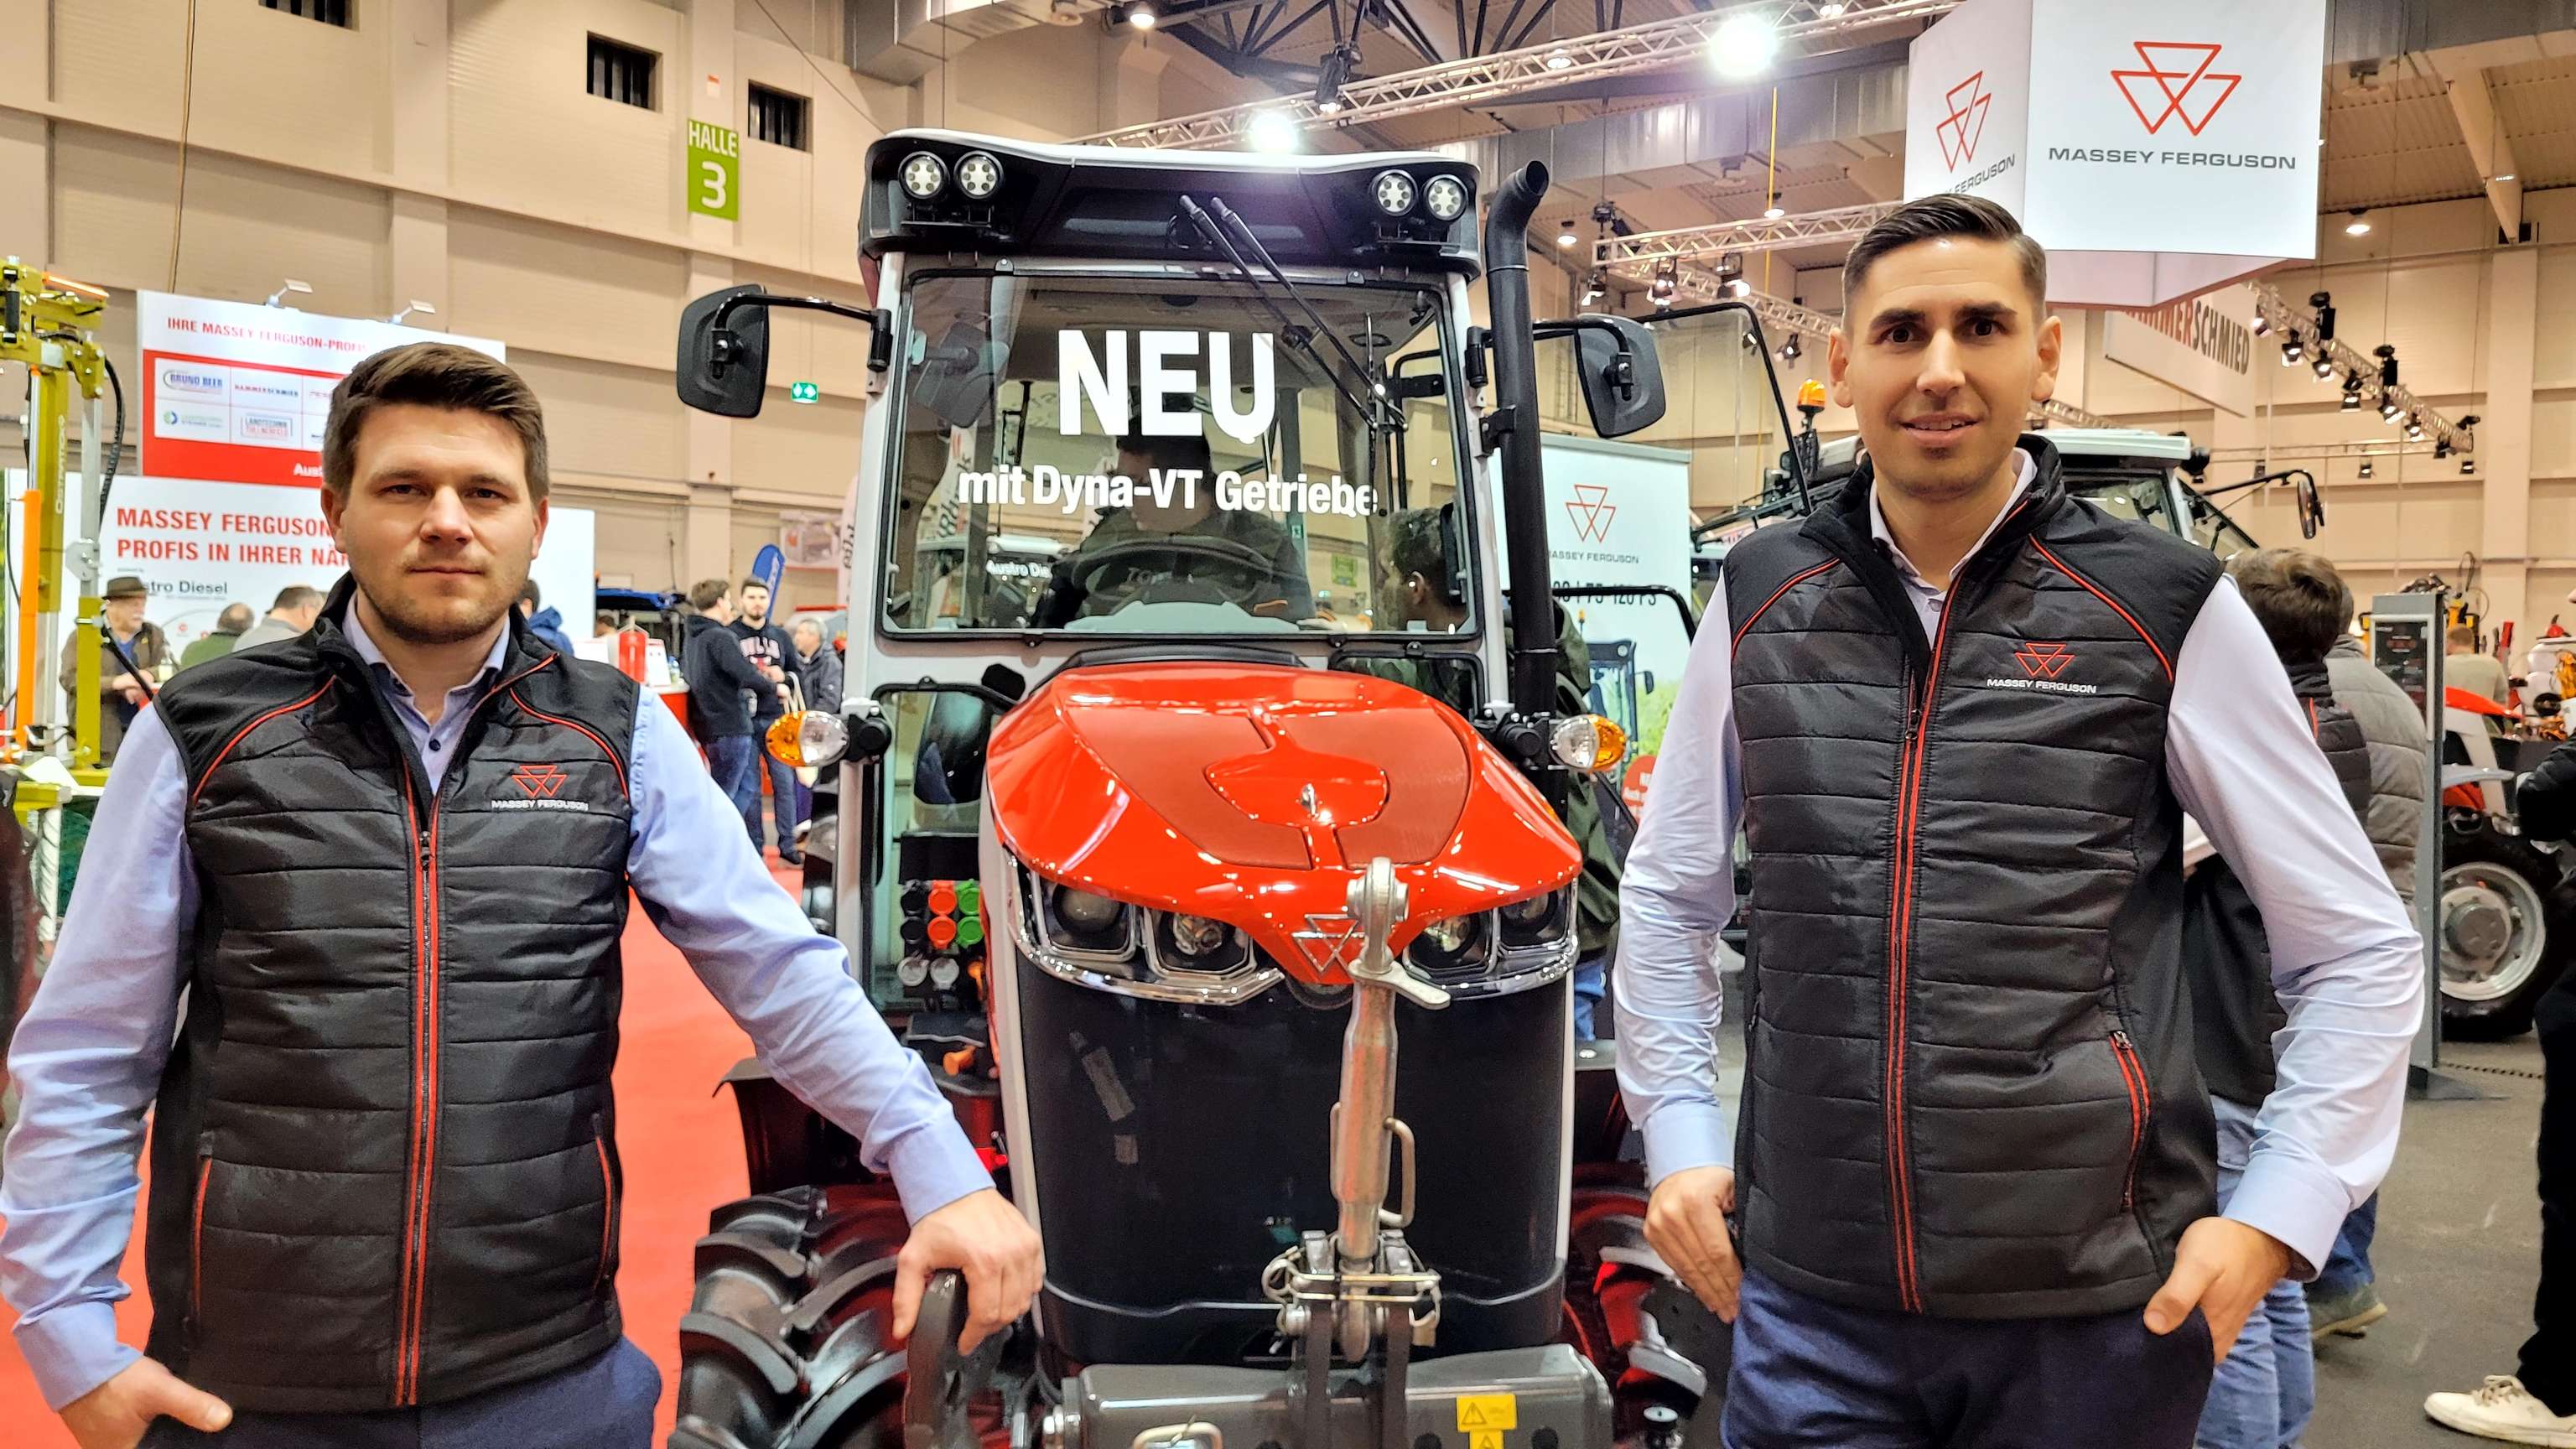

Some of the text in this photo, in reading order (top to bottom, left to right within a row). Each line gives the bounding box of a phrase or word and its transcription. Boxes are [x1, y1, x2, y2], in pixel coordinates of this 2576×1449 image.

[688, 120, 737, 158] HALLE
[2049, 148, 2296, 169] MASSEY FERGUSON
[701, 160, 727, 209] 3
[1954, 154, 2016, 194] FERGUSON
[167, 317, 198, 333] IHRE
[202, 322, 254, 339] MASSEY
[1058, 329, 1274, 438] NEU
[958, 465, 1026, 505] mit
[1032, 465, 1203, 515] Dyna-VT
[1215, 470, 1378, 518] Getriebe
[117, 508, 212, 532] MASSEY
[117, 539, 198, 560] PROFIS
[209, 543, 229, 561] IN
[240, 545, 302, 564] IHRER
[1550, 550, 1639, 564] ASSEY FERGUSON
[179, 581, 227, 594] Diesel
[1987, 678, 2096, 693] MASSEY FERGUSON
[491, 799, 589, 811] MASSEY FERGUSON
